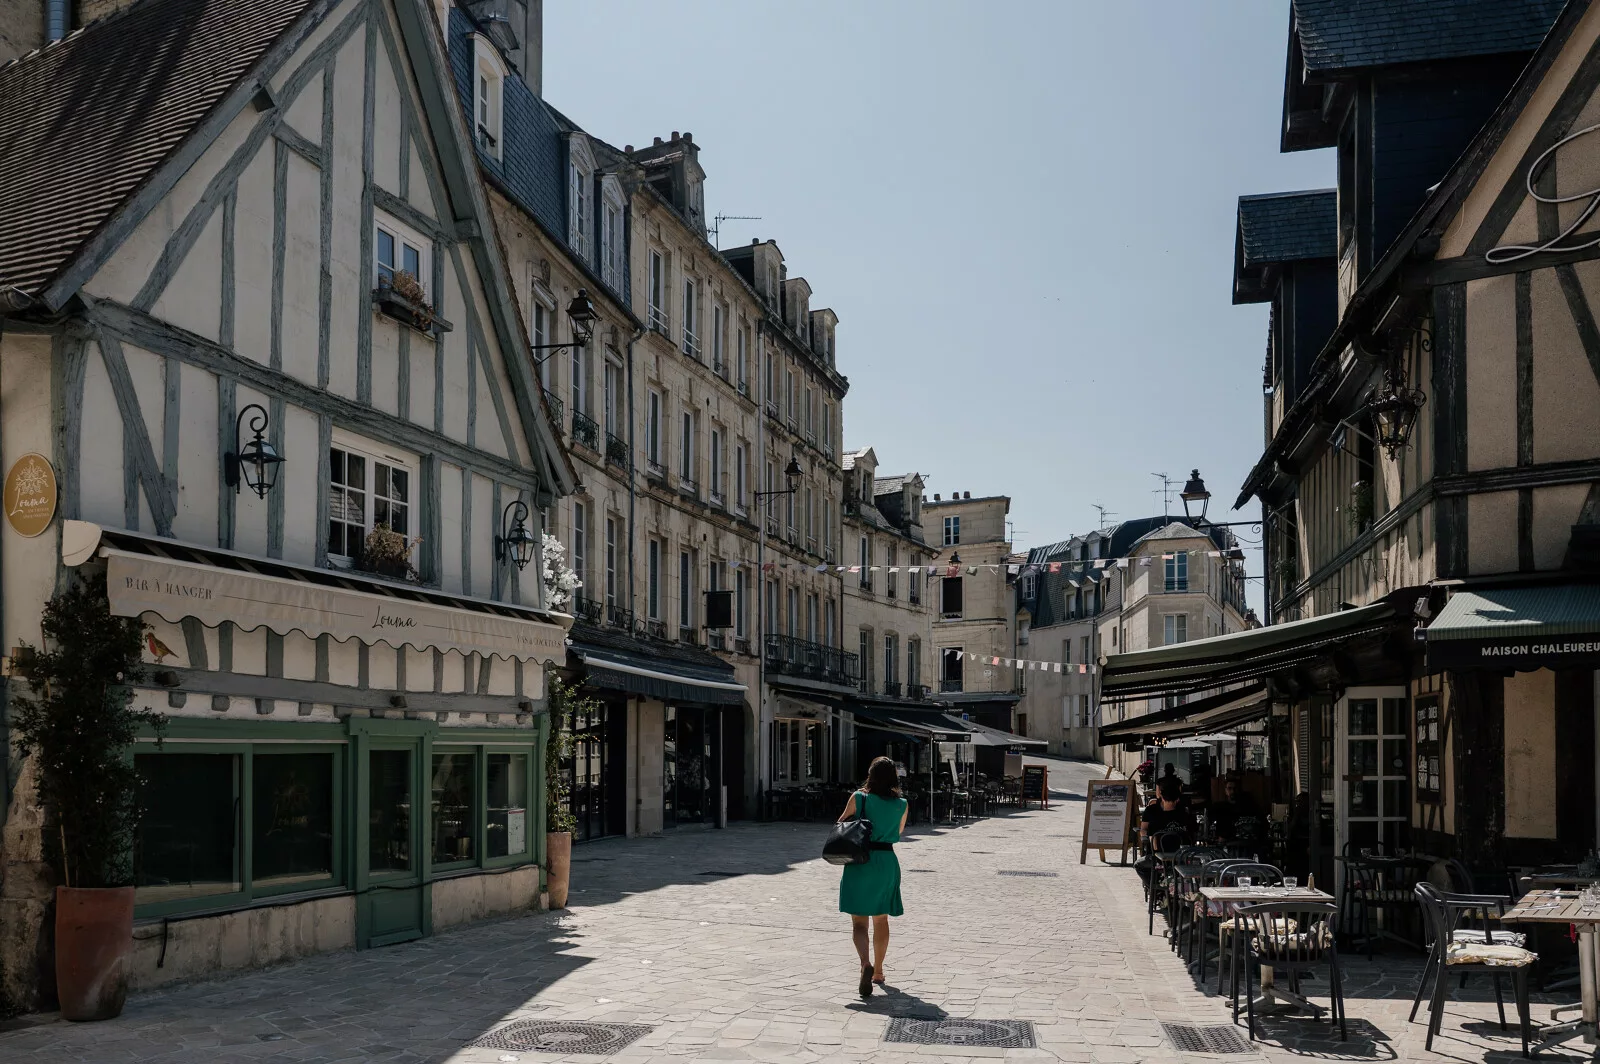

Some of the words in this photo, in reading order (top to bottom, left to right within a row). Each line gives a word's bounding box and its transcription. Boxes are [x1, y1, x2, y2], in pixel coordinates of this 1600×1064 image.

[10, 487, 48, 516] Louma
[126, 576, 149, 591] BAR
[372, 604, 418, 629] Louma
[1481, 645, 1528, 656] MAISON
[1531, 642, 1600, 654] CHALEUREU
